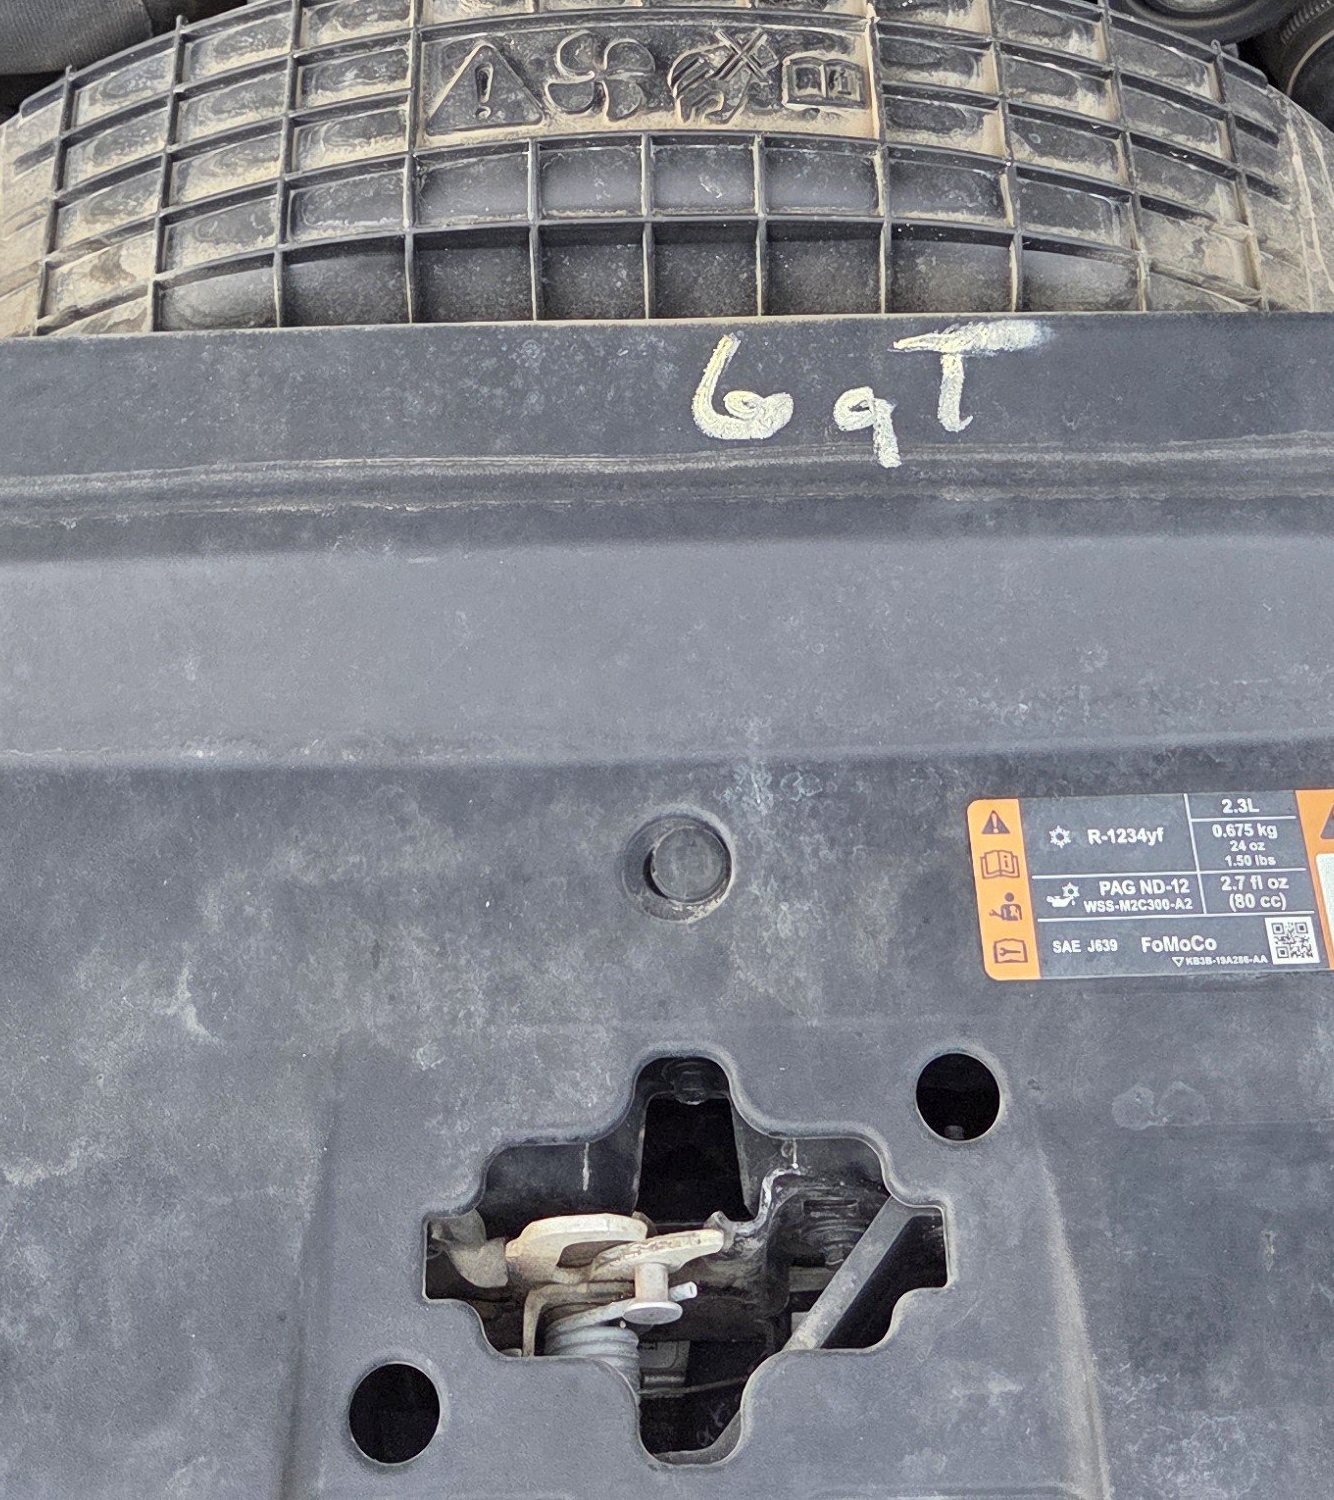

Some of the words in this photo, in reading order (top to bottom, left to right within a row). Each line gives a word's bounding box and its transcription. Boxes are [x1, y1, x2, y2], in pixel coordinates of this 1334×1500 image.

[691, 332, 794, 440] 6
[1221, 797, 1260, 814] 2.3L
[1087, 827, 1164, 846] R-1234yf
[1211, 823, 1254, 838] 0.675
[1256, 822, 1278, 839] kg
[1229, 840, 1247, 852] 24
[1248, 841, 1266, 852] oz
[1224, 854, 1253, 867] 1.50
[1254, 854, 1277, 866] lbs
[1099, 880, 1137, 896] PAG
[1139, 878, 1192, 896] ND-12
[1220, 875, 1245, 891] 2.7
[1250, 875, 1263, 890] fl
[1267, 877, 1289, 889] oz
[1083, 898, 1194, 913] WSS-M2C300-A2
[1229, 892, 1256, 912] (80
[1259, 891, 1288, 911] cc)
[1052, 939, 1082, 953] SAE
[1087, 938, 1119, 953] J639
[1141, 934, 1218, 953] FoMoCo
